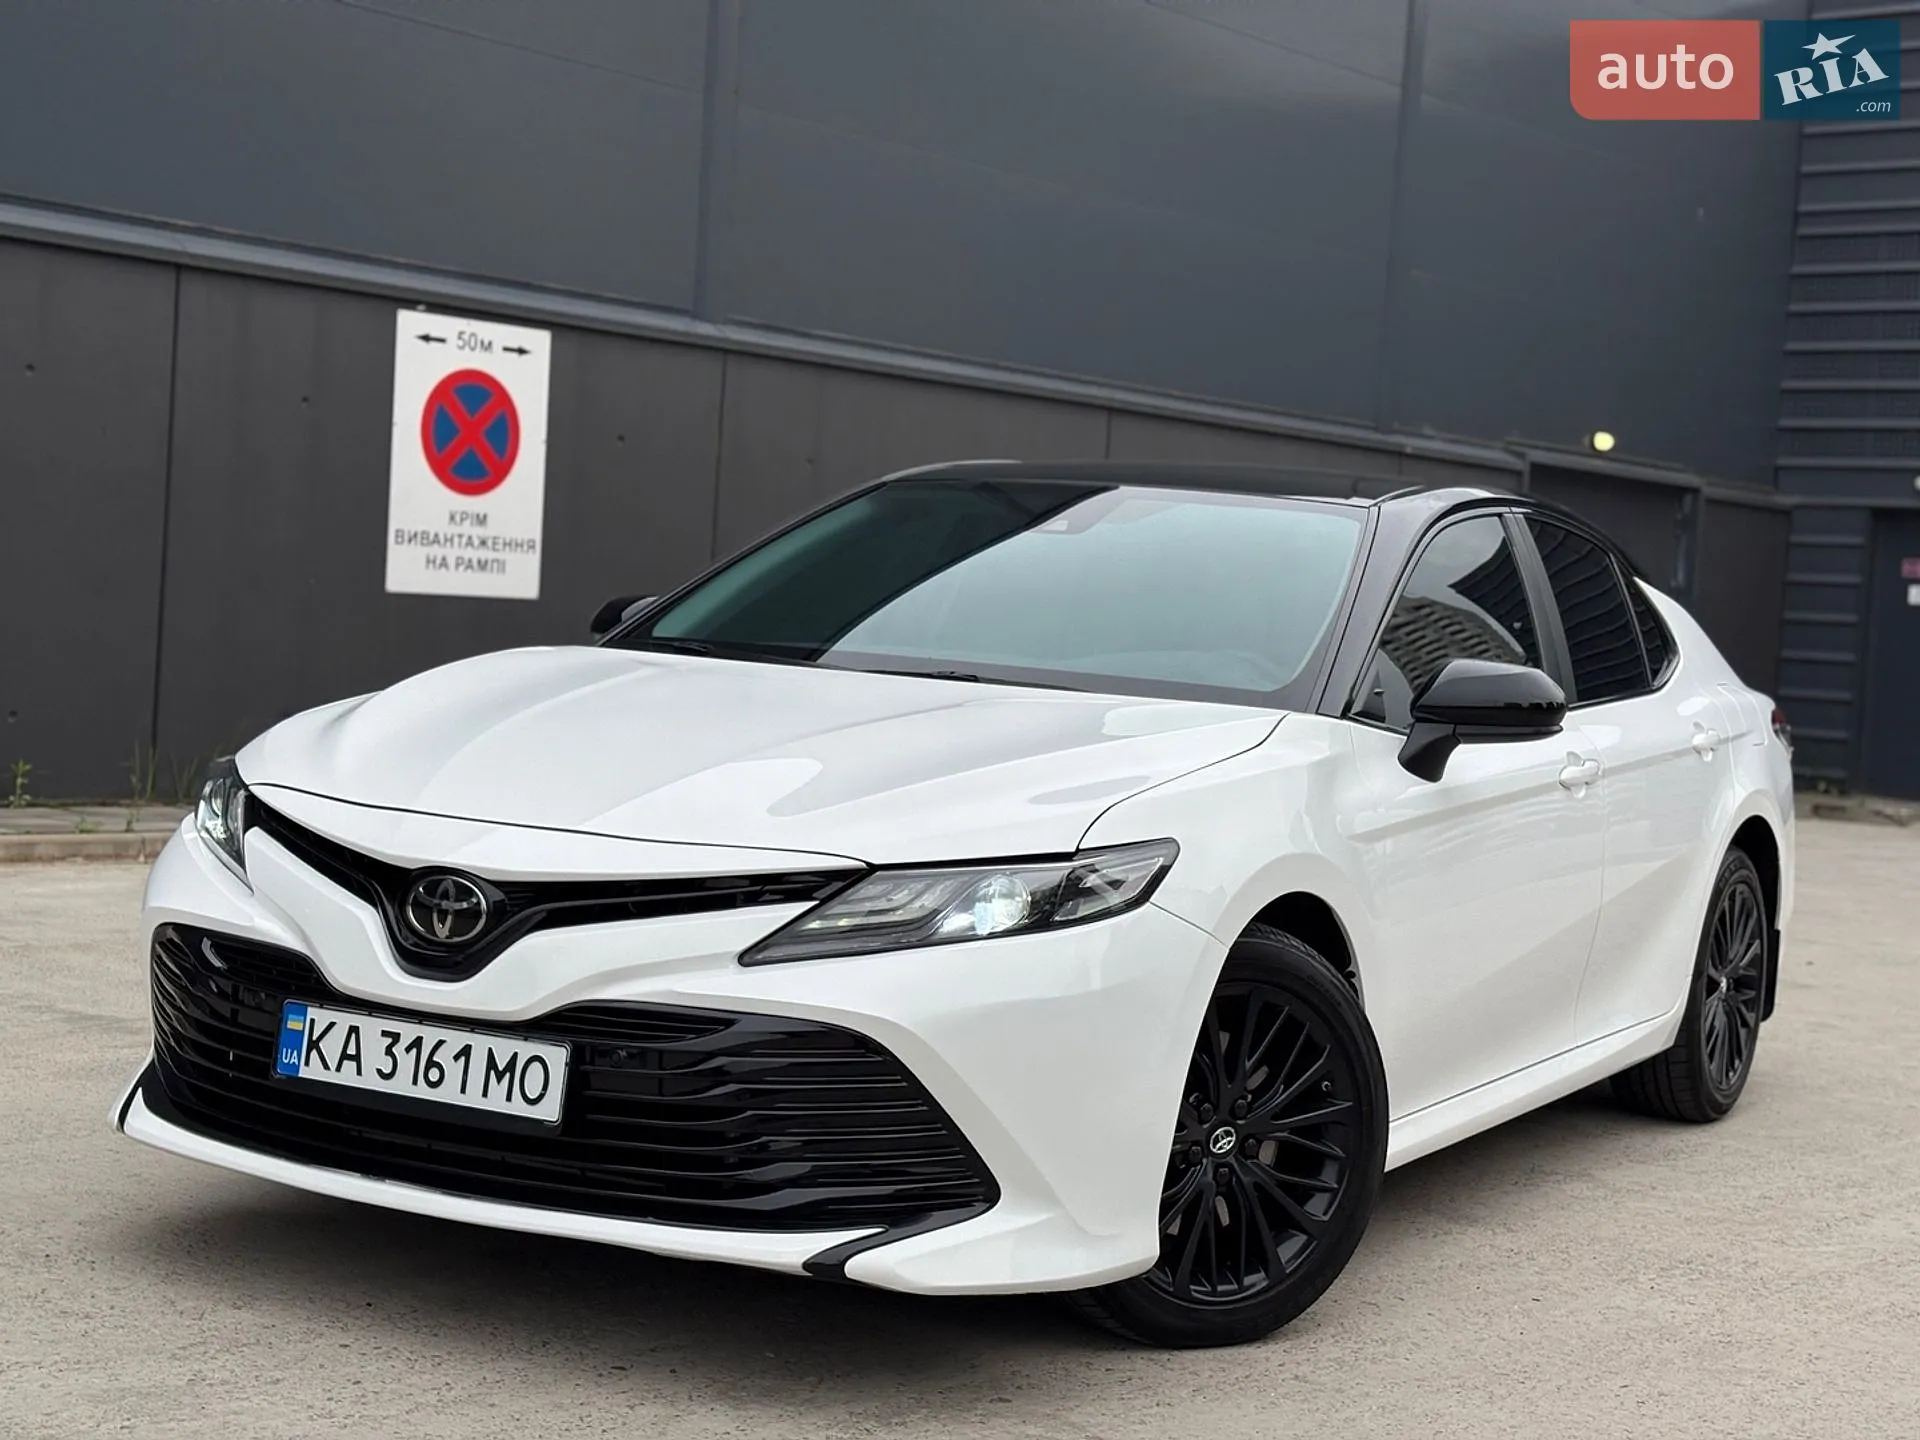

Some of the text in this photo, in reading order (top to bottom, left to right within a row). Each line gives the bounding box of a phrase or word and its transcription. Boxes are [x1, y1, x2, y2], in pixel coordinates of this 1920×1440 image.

[455, 331, 494, 353] 50м
[448, 510, 488, 528] КРІМ
[394, 528, 537, 555] ВИВАНТАЖЕННЯ
[425, 554, 506, 575] НА РАМПІ
[281, 1047, 299, 1066] UA
[303, 1017, 551, 1106] KA 3161 MO
